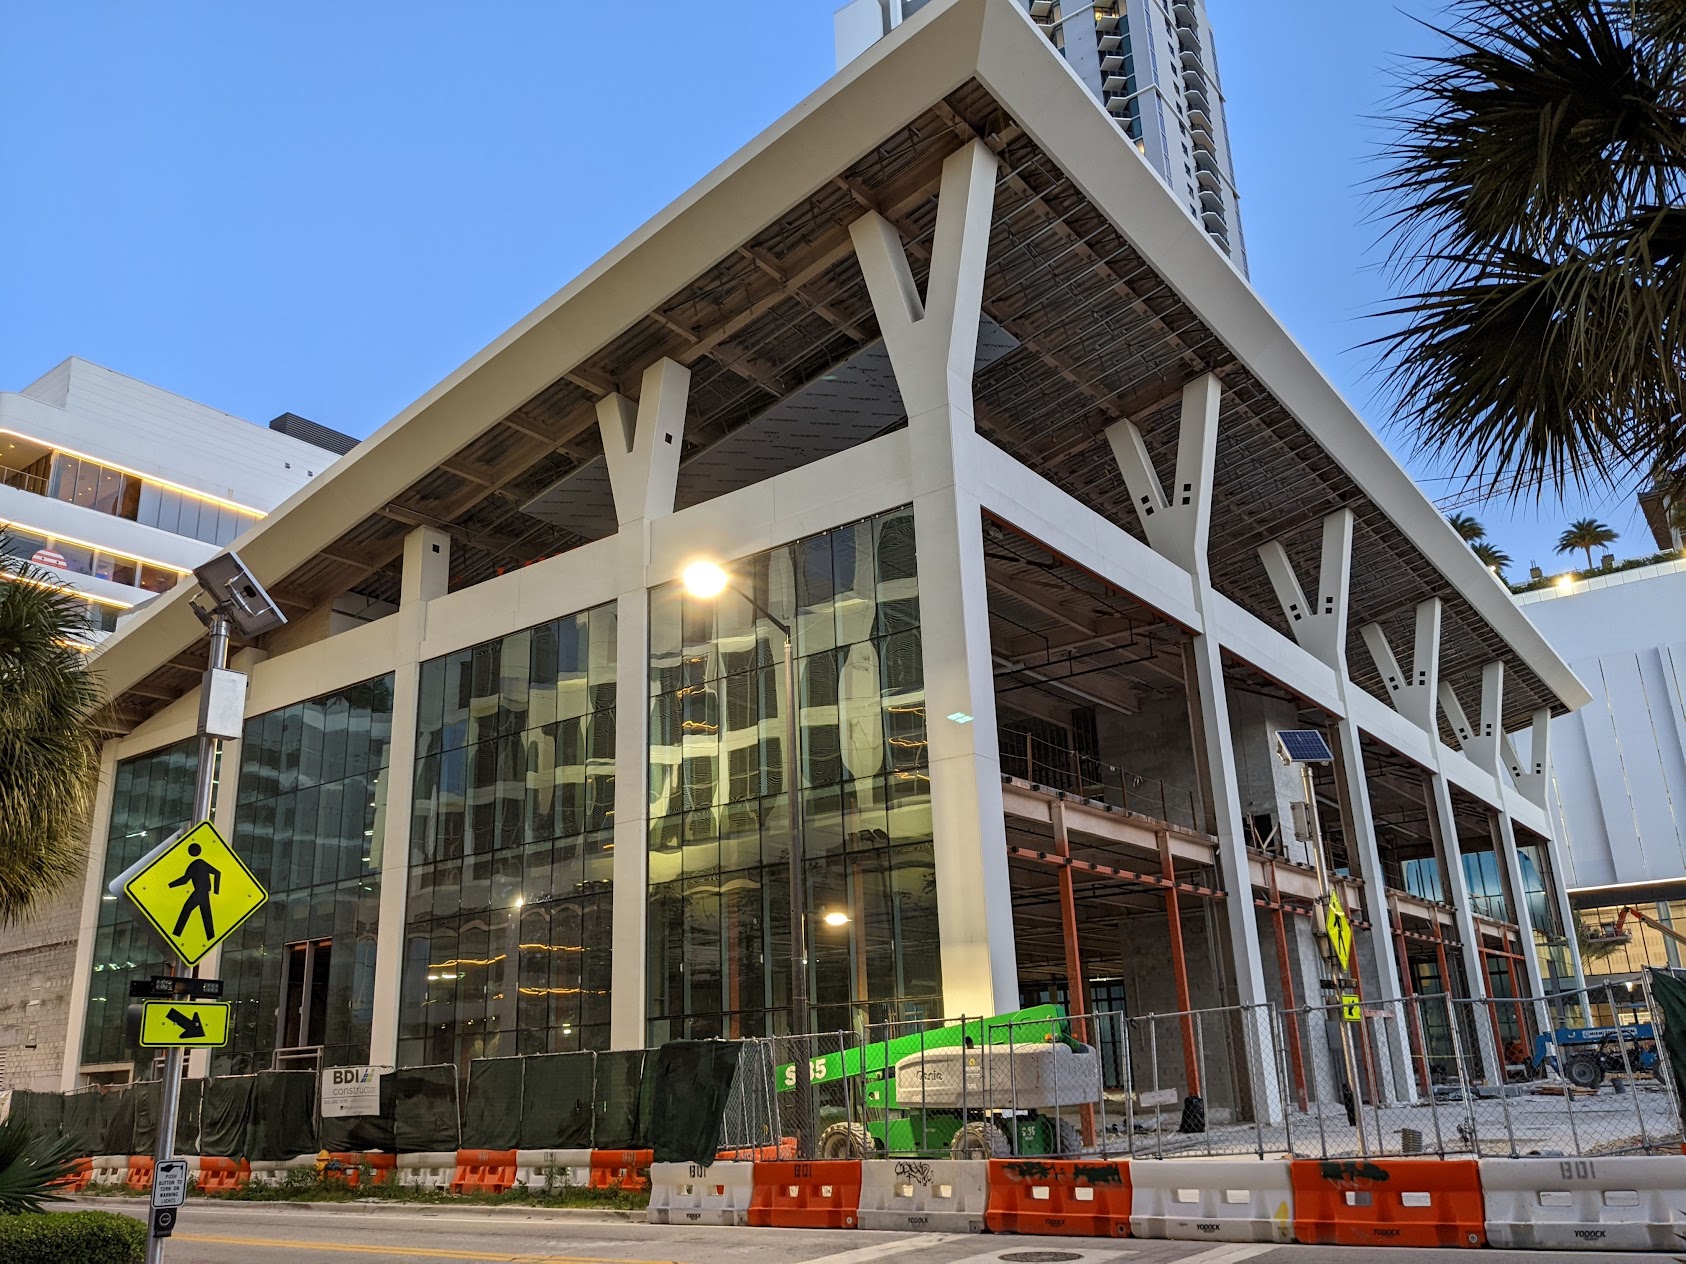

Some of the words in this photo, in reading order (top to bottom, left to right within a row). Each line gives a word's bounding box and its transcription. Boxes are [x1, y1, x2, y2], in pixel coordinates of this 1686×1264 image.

[333, 1069, 359, 1085] BDI
[689, 1165, 707, 1178] BDI
[794, 1164, 812, 1178] BDI
[1559, 1161, 1596, 1180] BDI
[1196, 1223, 1220, 1231] YODOCK
[1574, 1229, 1606, 1238] YODOCK
